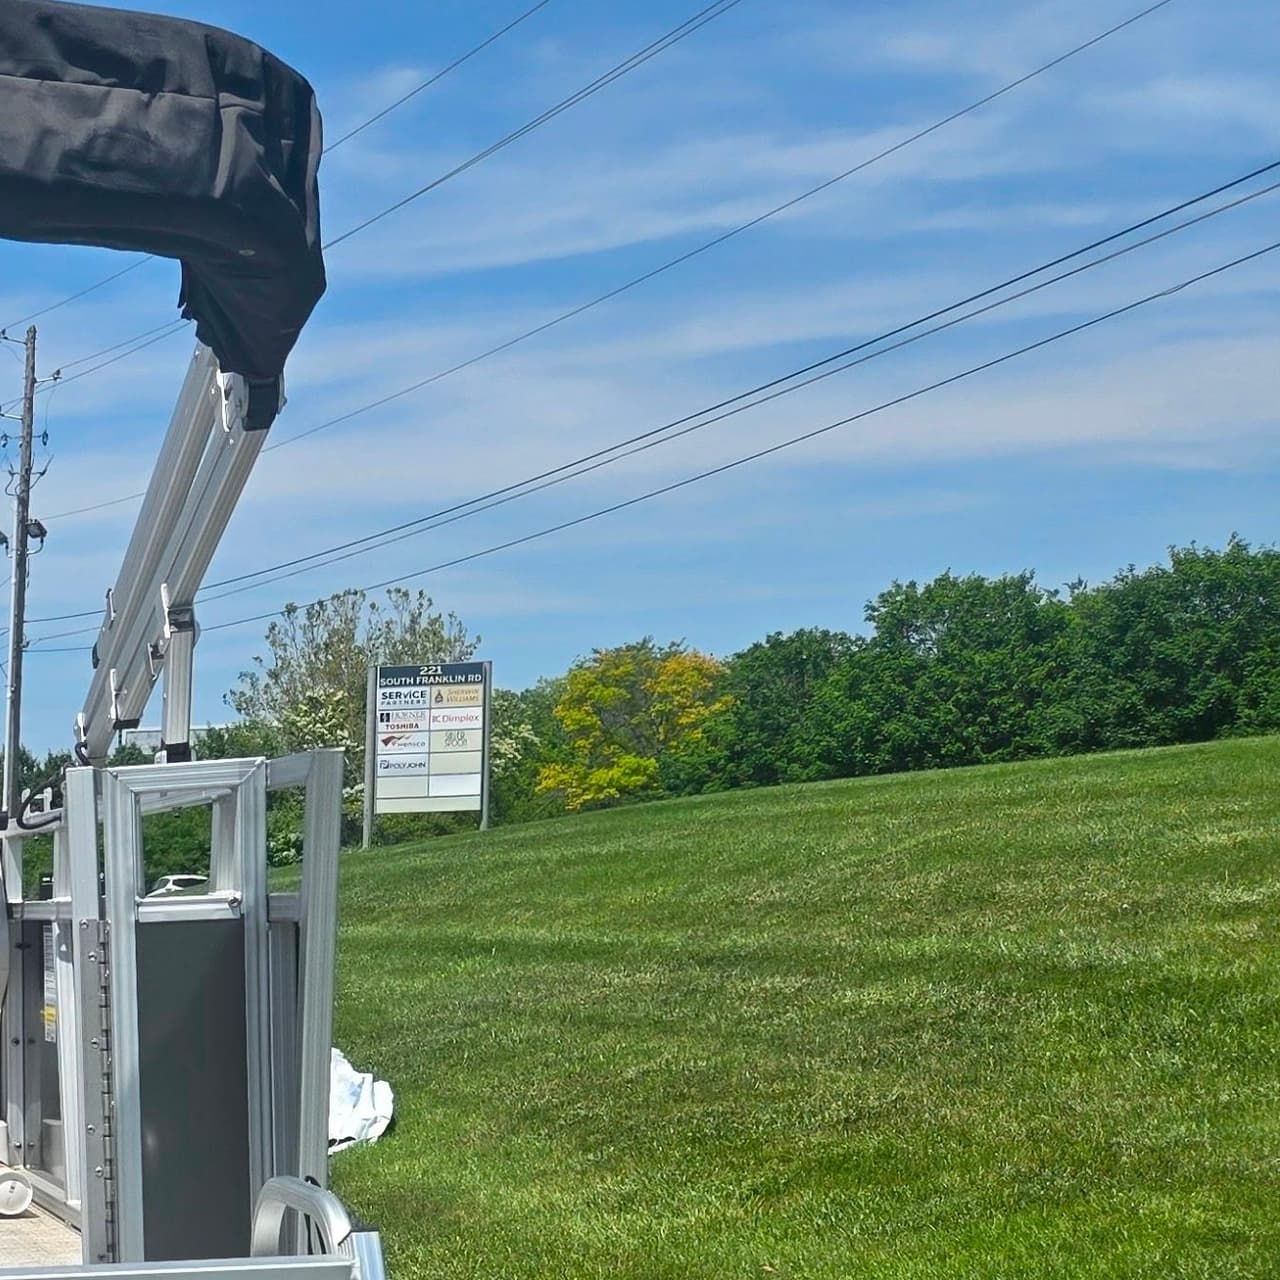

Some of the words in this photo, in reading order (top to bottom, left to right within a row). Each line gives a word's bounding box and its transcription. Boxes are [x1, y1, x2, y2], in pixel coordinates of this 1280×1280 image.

[419, 666, 443, 675] 221
[380, 677, 414, 687] SOUTH
[416, 674, 465, 684] FRANKLIN
[468, 673, 482, 682] RD
[385, 723, 420, 731] TOSHIBA
